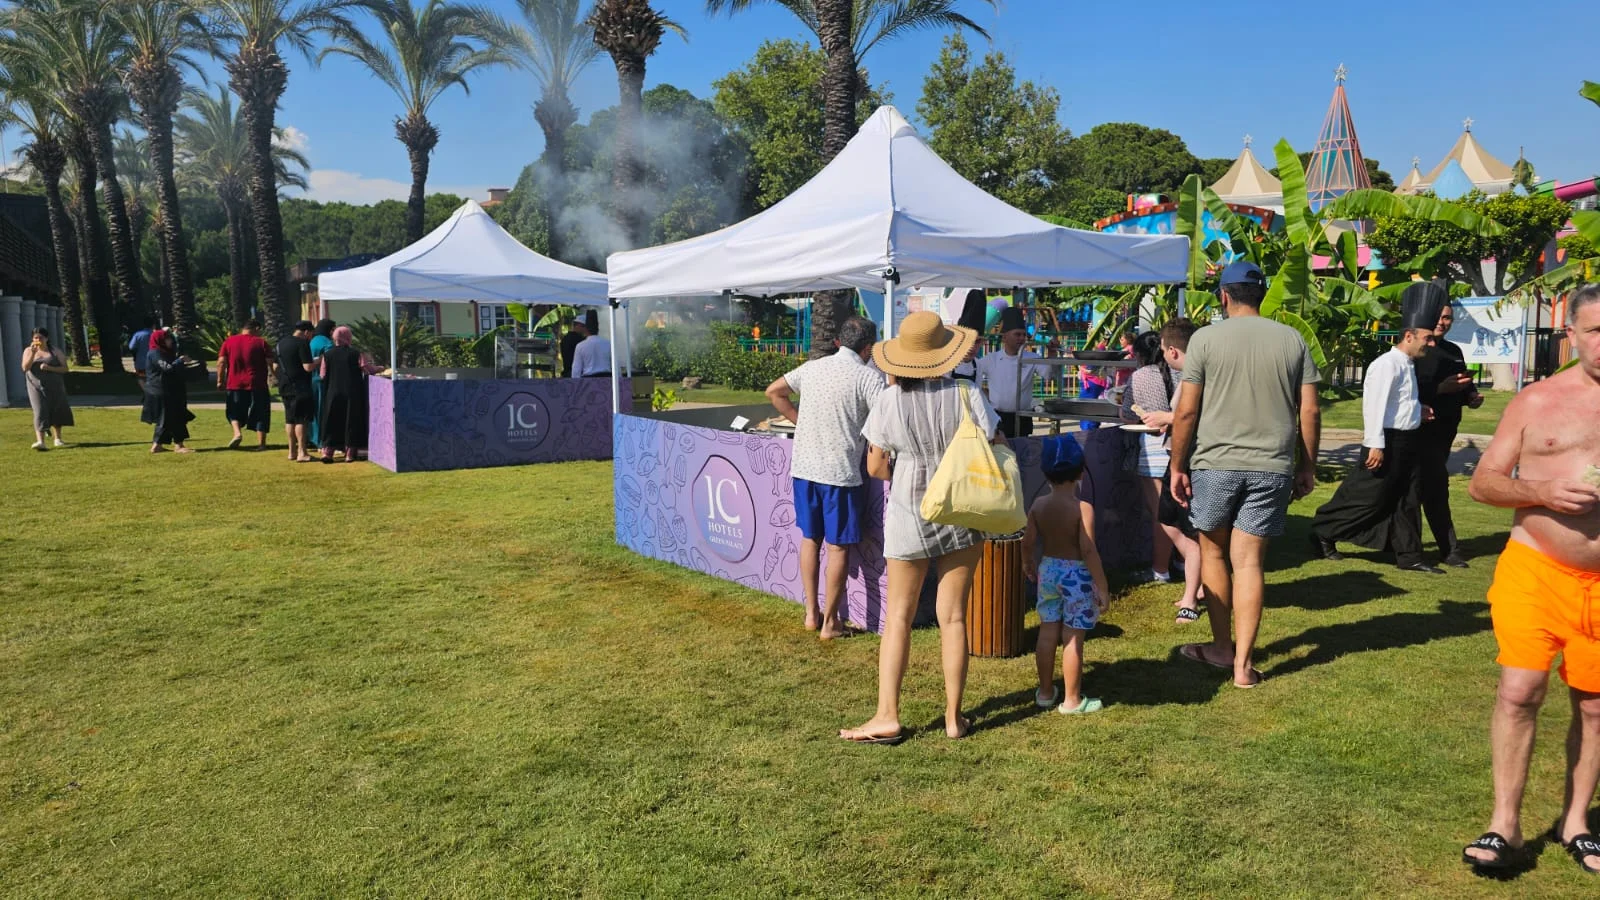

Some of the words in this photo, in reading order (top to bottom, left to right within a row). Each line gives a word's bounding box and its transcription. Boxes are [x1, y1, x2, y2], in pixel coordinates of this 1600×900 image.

[507, 403, 537, 429] IC
[704, 474, 740, 524] IC
[708, 521, 742, 538] HOTELS
